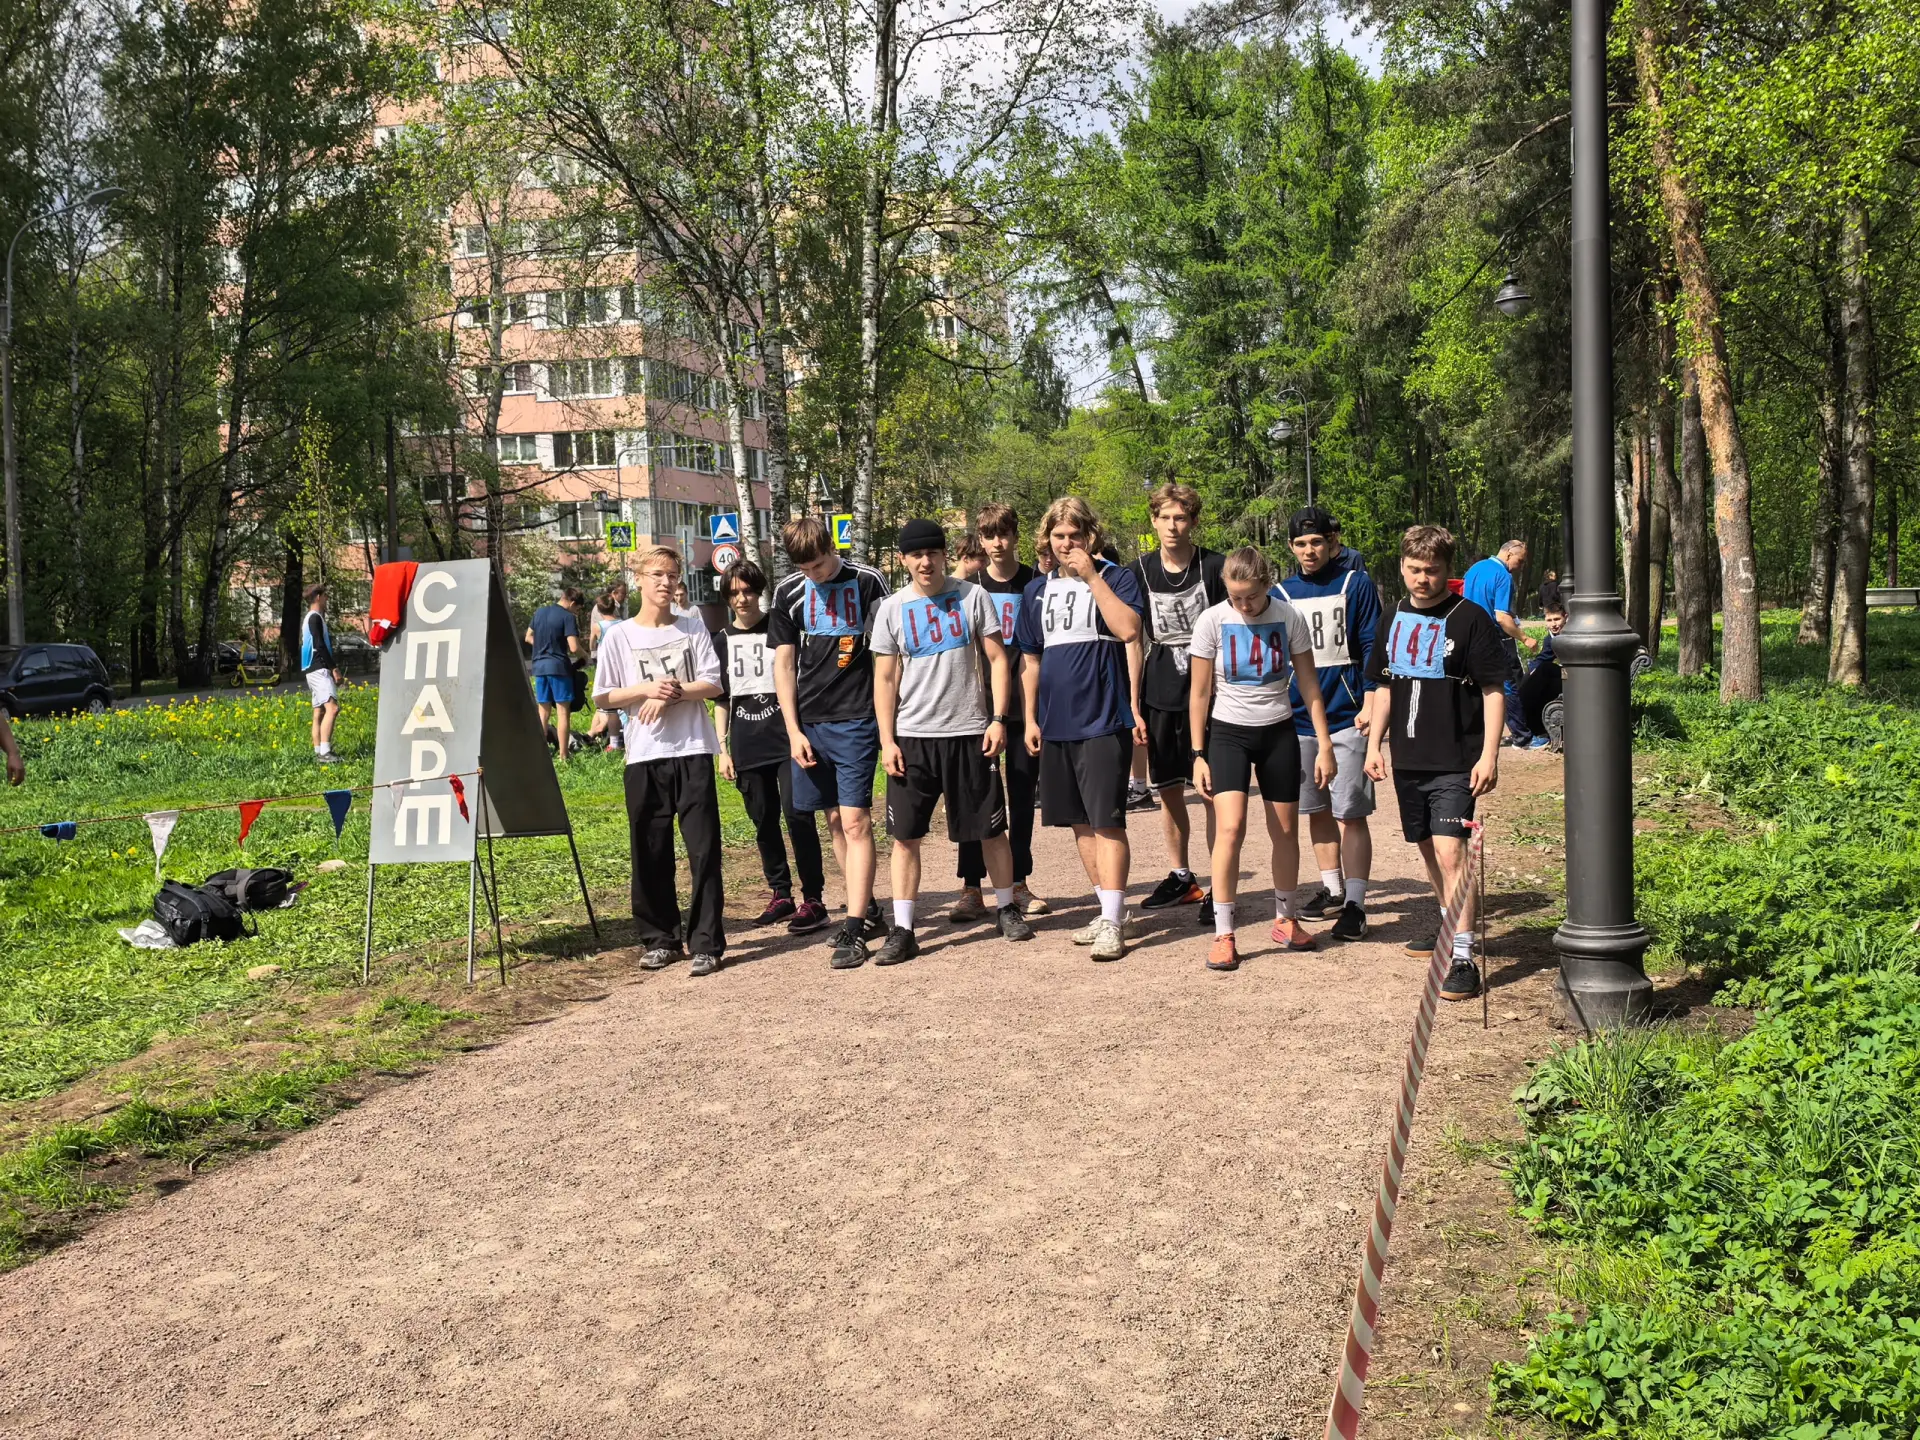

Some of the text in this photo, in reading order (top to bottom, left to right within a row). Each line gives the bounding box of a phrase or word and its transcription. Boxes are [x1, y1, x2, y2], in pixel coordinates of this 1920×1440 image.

[719, 553, 733, 564] 40
[808, 587, 857, 628] 146
[908, 597, 963, 648] 155
[1045, 589, 1092, 633] 537
[1312, 607, 1345, 650] 83
[733, 642, 765, 678] 53
[1229, 631, 1283, 677] 148
[1391, 620, 1441, 667] 147
